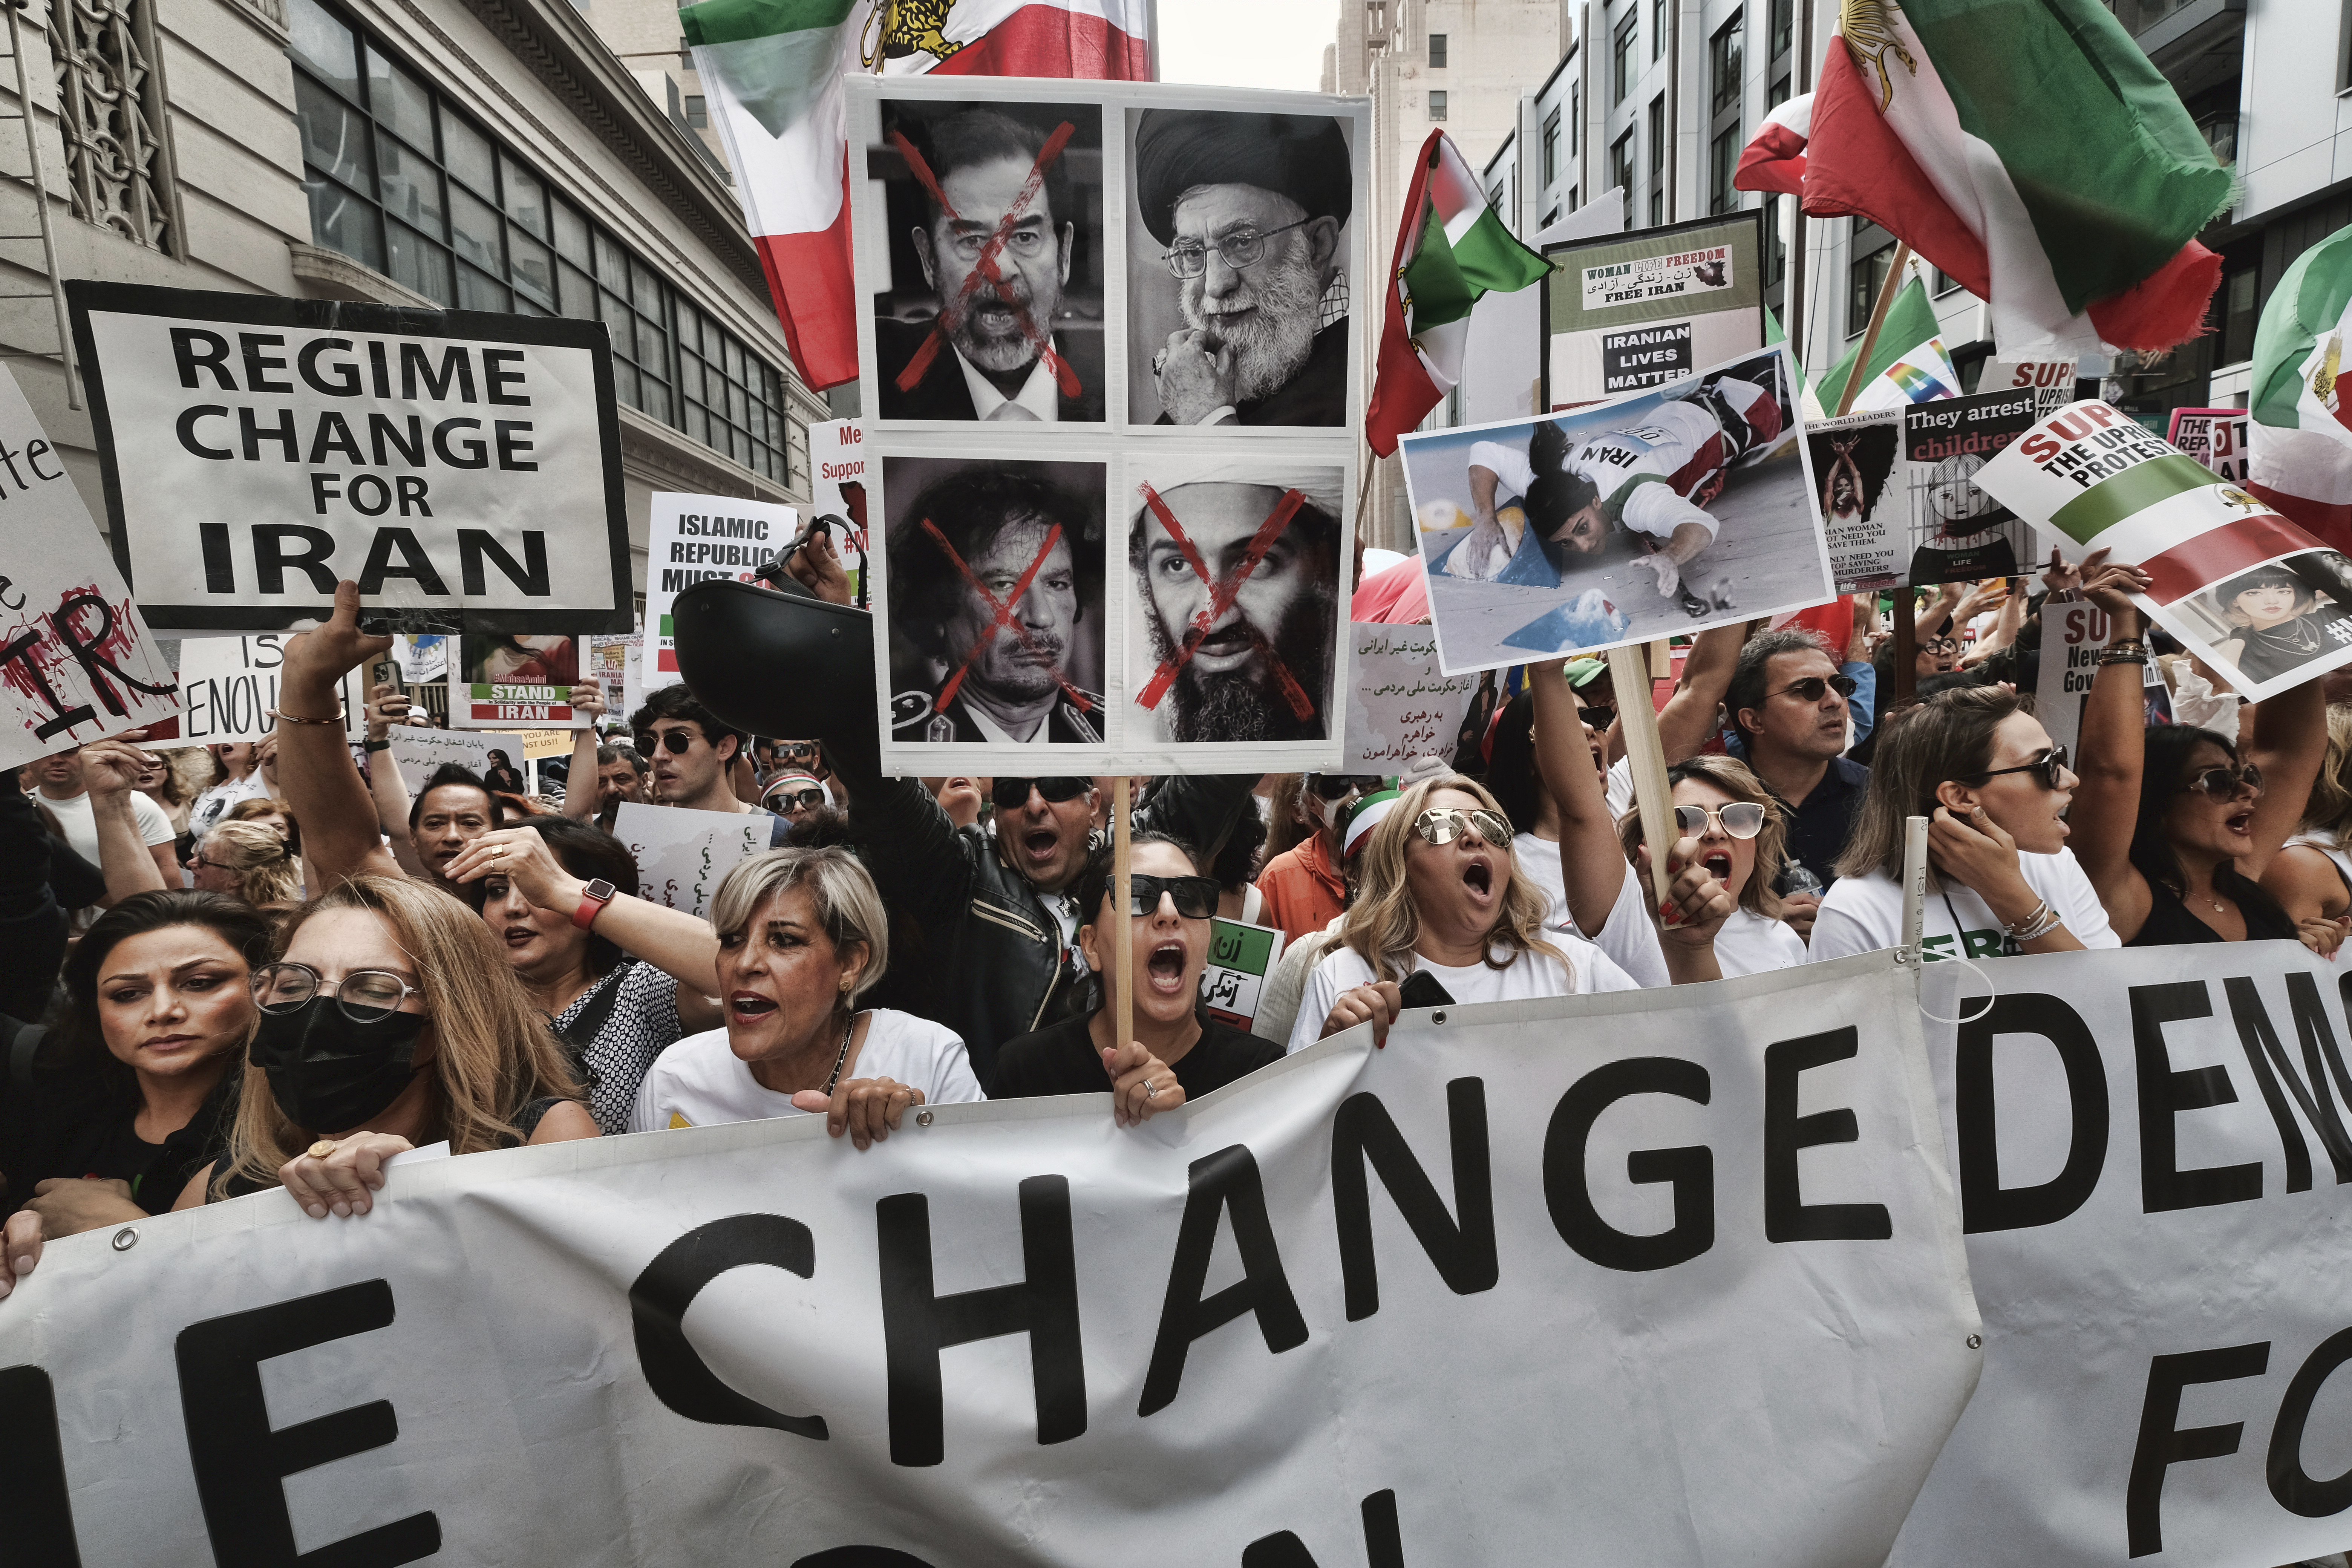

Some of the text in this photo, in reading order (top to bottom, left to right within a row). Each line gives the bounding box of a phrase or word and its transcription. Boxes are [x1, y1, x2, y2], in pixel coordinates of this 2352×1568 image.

[1587, 248, 1725, 280] WOMAN LIFE FREEDOM
[1588, 267, 1692, 294] زن زندگی آزادی
[1605, 282, 1685, 303] FREE IRAN
[1607, 326, 1690, 349] IRANIAN
[169, 327, 531, 407] REGIME
[1620, 349, 1677, 367] LIVES
[1608, 368, 1692, 390] MATTER
[1822, 418, 1855, 427] WORLD
[1857, 411, 1896, 422] LEADERS
[1906, 397, 2034, 430] They arrest
[176, 404, 539, 472] CHANGE
[840, 426, 864, 446] Me
[2020, 404, 2135, 463] SUP
[1580, 446, 1639, 469] IRAN
[2041, 443, 2097, 478] THE
[2069, 440, 2177, 488] PROTEST
[310, 472, 433, 518] FOR
[678, 514, 769, 541] ISLAMIC
[1847, 523, 1883, 532] WOMAN
[199, 522, 551, 596] IRAN
[670, 542, 775, 567] REPUBLIC
[1849, 559, 1880, 567] SAVING
[1947, 551, 1980, 559] WOMAN
[1834, 565, 1889, 576] MURDERERS!
[1945, 565, 1986, 574] FREEDOM
[1358, 638, 1389, 655] ایرانی
[1389, 640, 1408, 655] غیر
[2067, 646, 2102, 668] New
[494, 674, 547, 684] #MahsaAmini
[1424, 666, 1431, 675] و
[492, 685, 555, 700] STAND
[1374, 683, 1405, 696] مردمی
[1407, 680, 1426, 697] ملی
[1427, 678, 1457, 695] حکومت
[1458, 675, 1474, 694] آغاز
[498, 705, 549, 720] IRAN
[1400, 710, 1443, 723] به رهبری
[466, 740, 484, 749] پایان
[541, 738, 558, 747] US!!
[1401, 725, 1436, 746] خواهرم
[423, 758, 436, 766] ملی
[1362, 744, 1418, 761] خواهرامون
[698, 847, 711, 881] مردمی
[1216, 931, 1244, 963] زن
[1955, 970, 2352, 1235] DEM
[628, 1024, 1893, 1467] CHANGE
